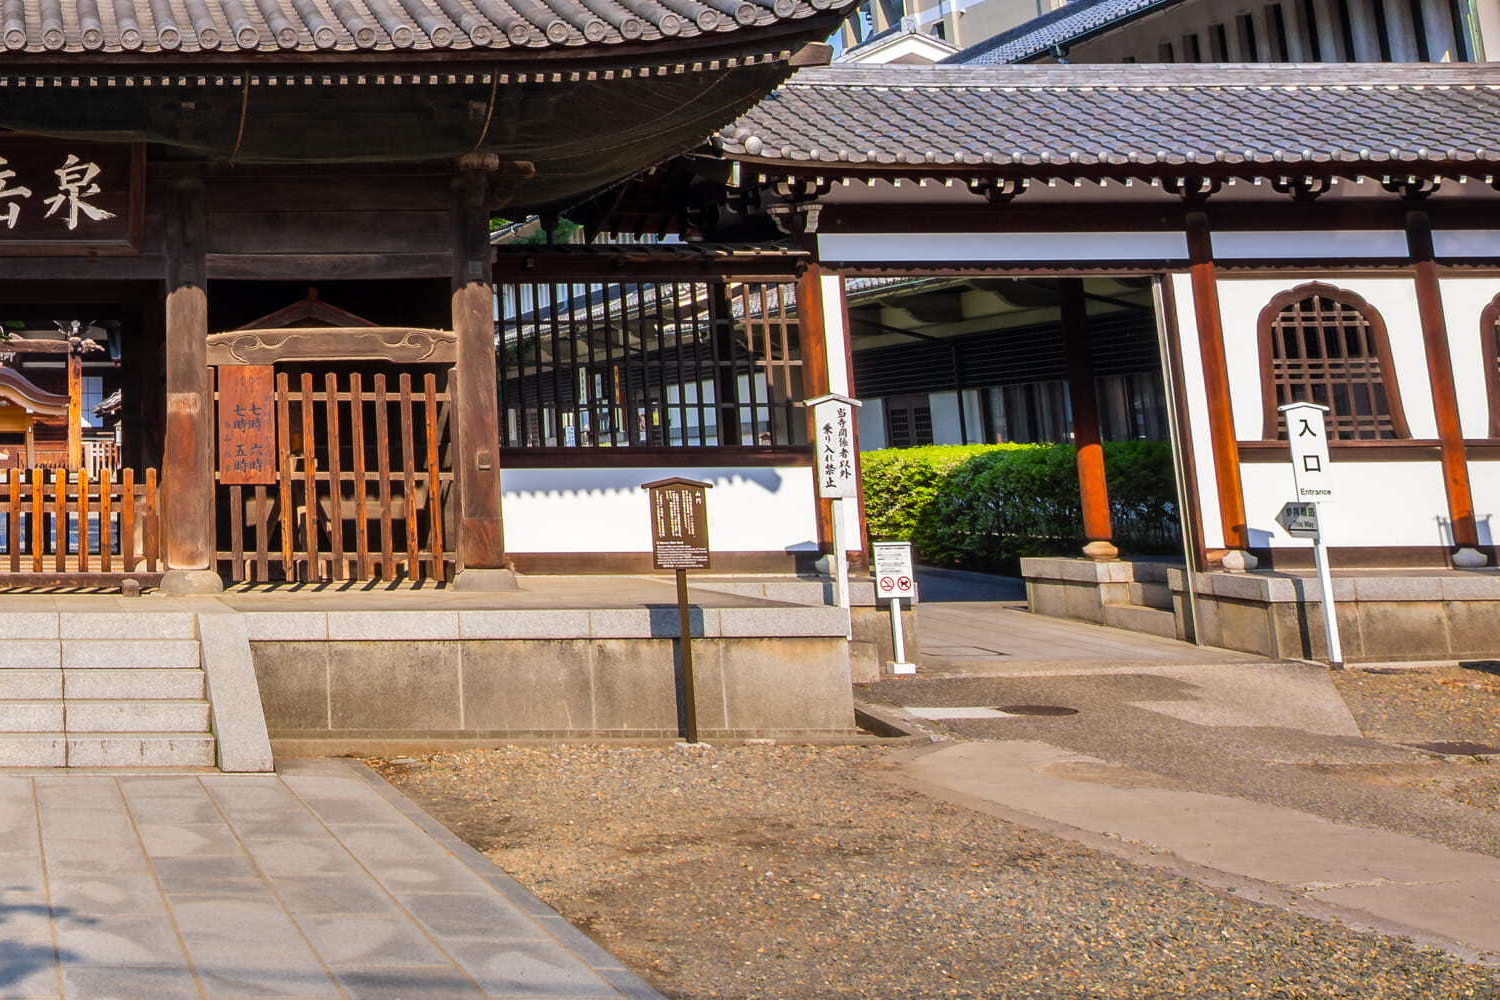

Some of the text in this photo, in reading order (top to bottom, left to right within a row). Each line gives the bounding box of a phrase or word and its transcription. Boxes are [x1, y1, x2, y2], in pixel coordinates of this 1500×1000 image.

[822, 423, 837, 488] 乗り入れ禁止
[1298, 419, 1322, 473] 入口
[1300, 488, 1332, 496] Entrance
